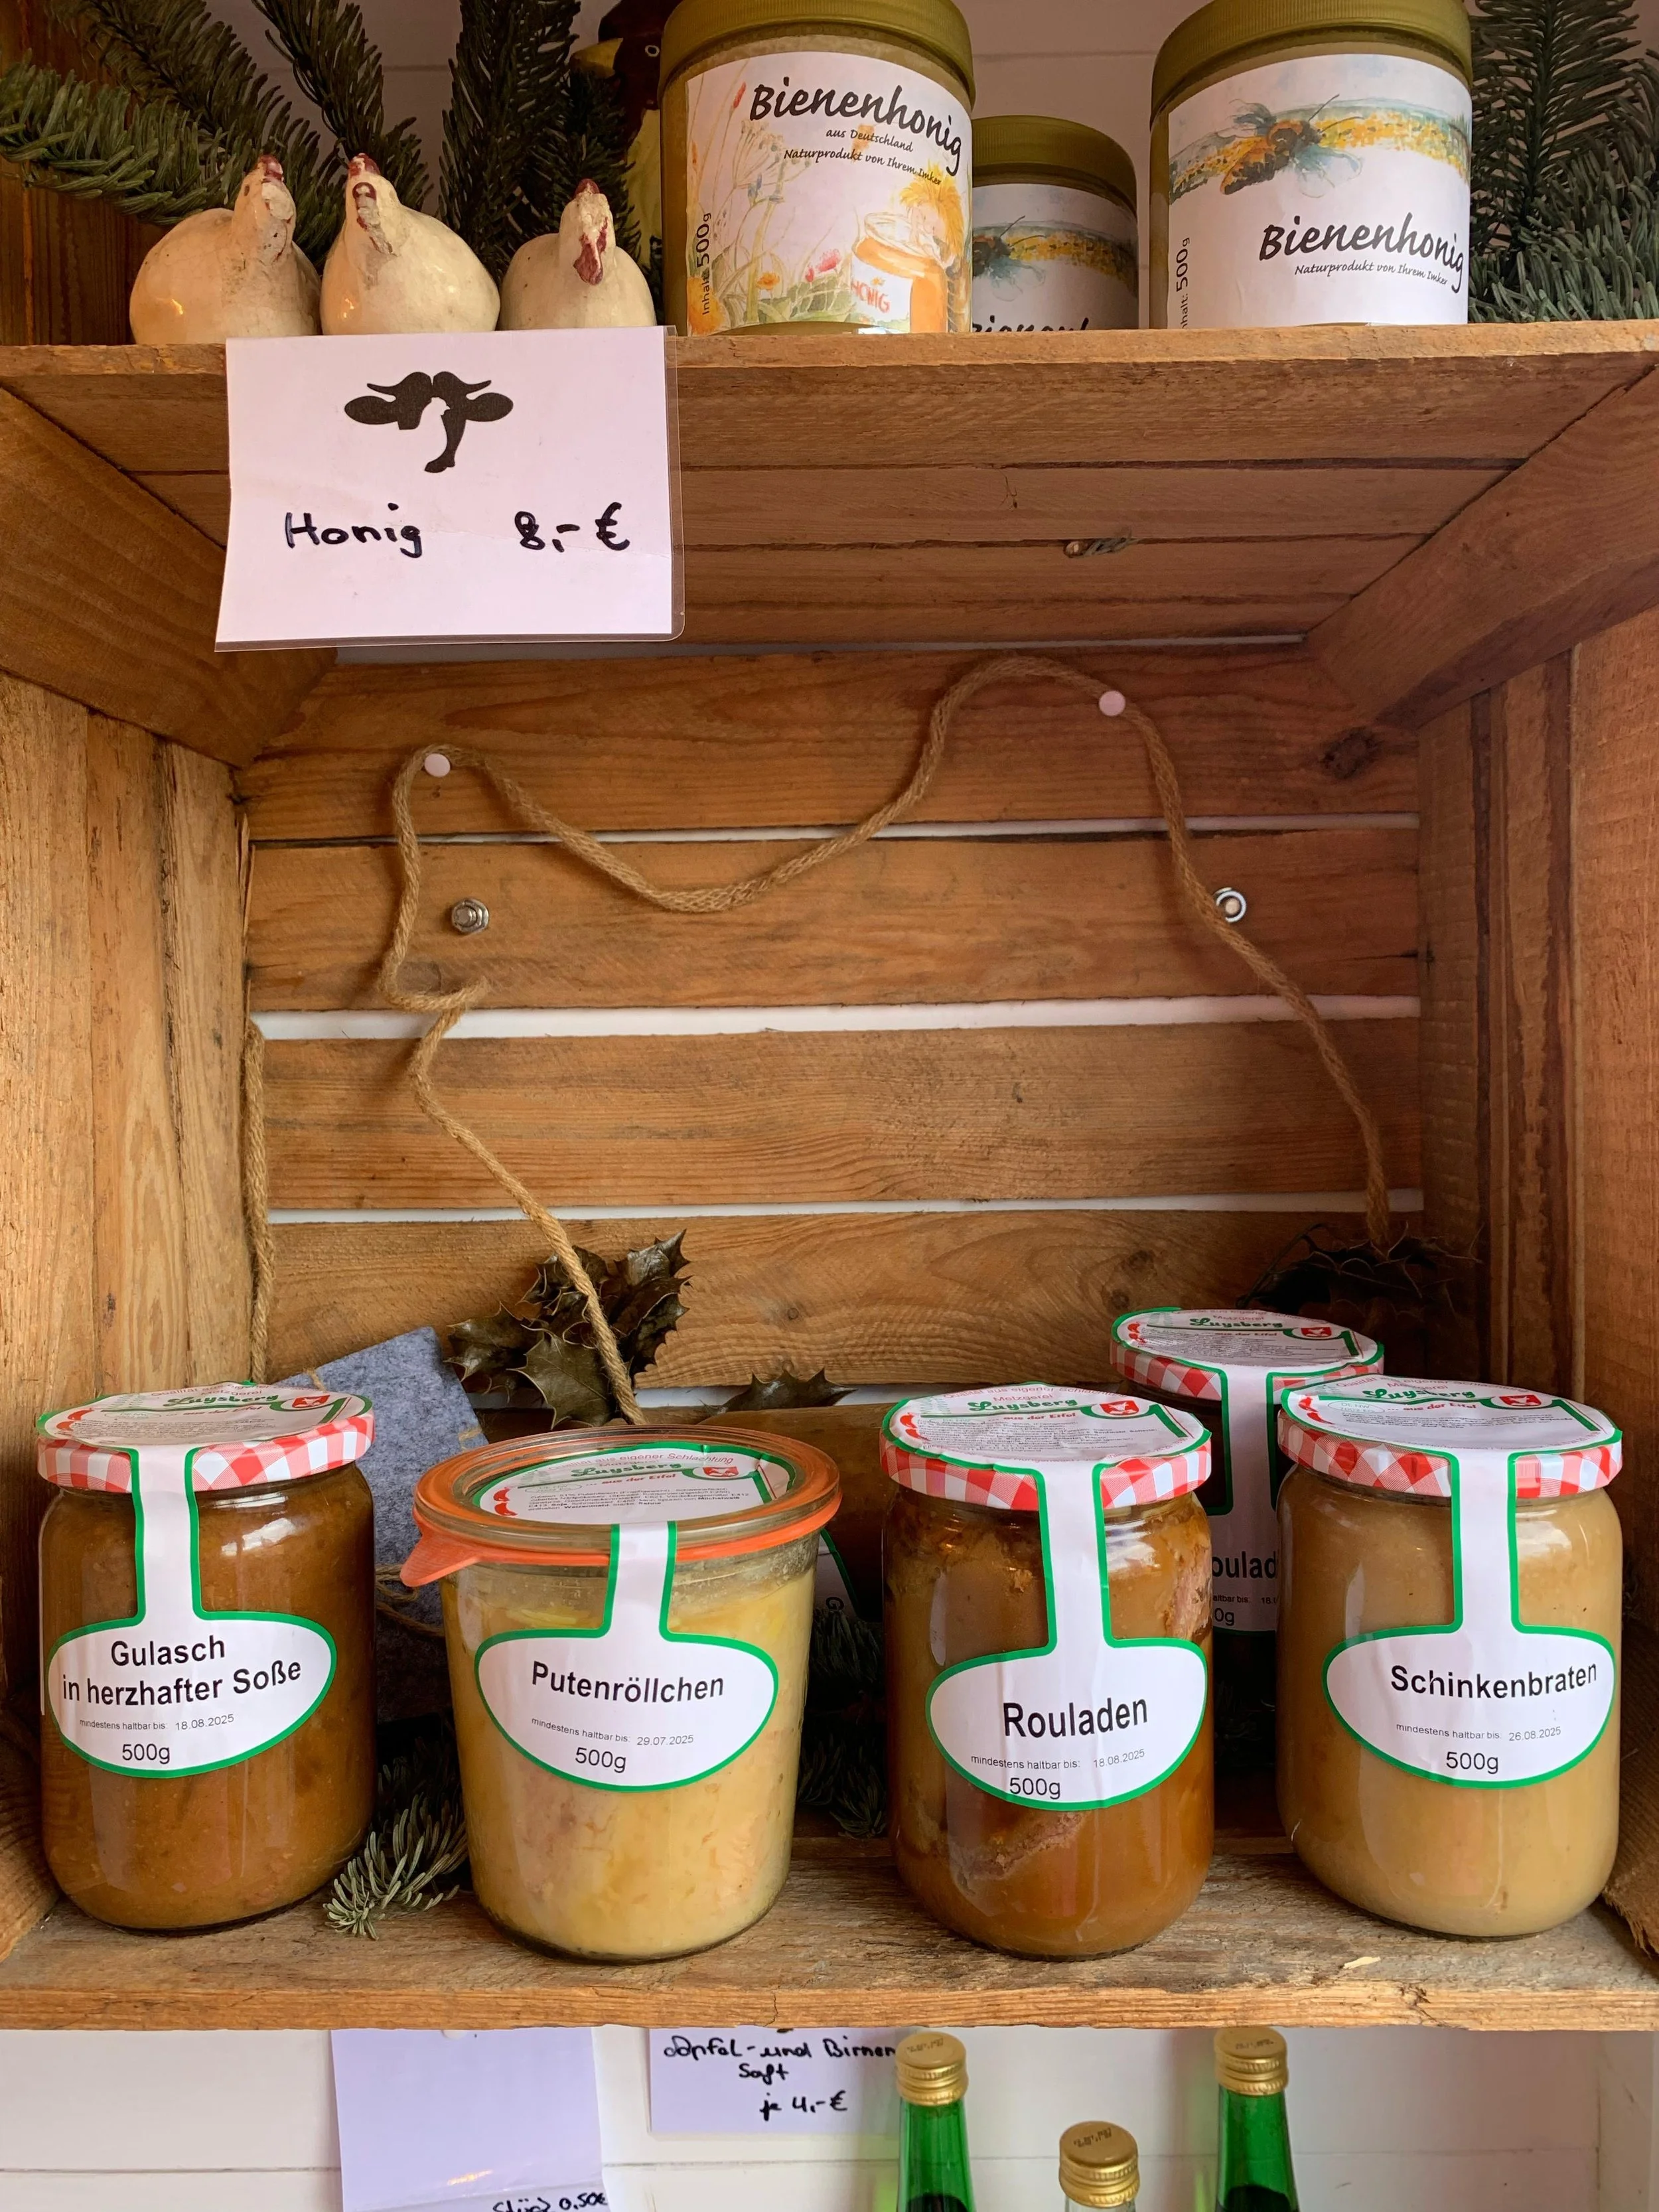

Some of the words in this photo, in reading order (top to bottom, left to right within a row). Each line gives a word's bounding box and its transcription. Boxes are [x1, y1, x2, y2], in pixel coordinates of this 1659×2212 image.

[750, 76, 962, 177] Bienenhonig
[826, 129, 845, 138] aus
[850, 129, 914, 152] Deutschland
[784, 147, 863, 163] Naturprodukt
[865, 153, 885, 165] von
[887, 157, 916, 175] Ihrem
[918, 168, 941, 185] Imker
[695, 213, 711, 268] 500g
[1259, 212, 1464, 293] Bienenhonig
[1176, 238, 1190, 292] 500g
[1295, 260, 1374, 276] Naturprodukt
[1376, 263, 1396, 273] von
[1397, 263, 1426, 278] Ihrem
[1427, 270, 1448, 285] Imker
[851, 281, 890, 313] HONIG
[284, 502, 423, 558] Honig
[514, 510, 580, 553] 8,-
[595, 501, 630, 551] €
[1189, 1317, 1283, 1327] Luysberg
[1336, 1377, 1377, 1388] Qualität
[163, 1394, 279, 1406] Luysberg
[968, 1399, 1078, 1411] Luysberg
[571, 1463, 682, 1477] Luysberg
[667, 1453, 734, 1465] Schlachtung
[1212, 1551, 1277, 1579] oulad
[111, 1635, 225, 1666] Gulasch
[62, 1674, 80, 1701] in
[88, 1677, 223, 1706] herzhafter
[233, 1659, 302, 1694] Soße
[532, 1660, 724, 1704] Putenröllchen
[1390, 1662, 1597, 1699] Schinkenbraten
[80, 1719, 120, 1730] mindestens
[175, 1714, 234, 1730] 18.08.2025
[1003, 1697, 1148, 1739] Rouladen
[532, 1718, 579, 1737] mindestens
[582, 1730, 614, 1741] haltbar
[637, 1733, 694, 1747] 29.07.2025
[1396, 1724, 1449, 1737] mindestens
[1508, 1726, 1561, 1741] 26.08.2025
[121, 1743, 171, 1765] 500g
[575, 1746, 626, 1773] 500g
[971, 1754, 1025, 1769] mindestens
[1027, 1759, 1061, 1770] haltbar
[1064, 1759, 1080, 1769] bis:
[1093, 1748, 1145, 1768] 18.08.2025
[1445, 1751, 1499, 1775] 500g
[1009, 1777, 1061, 1800] 500g
[739, 2063, 789, 2085] Saft
[760, 2093, 782, 2122] je
[792, 2096, 825, 2113] 4,-
[829, 2090, 847, 2112] €
